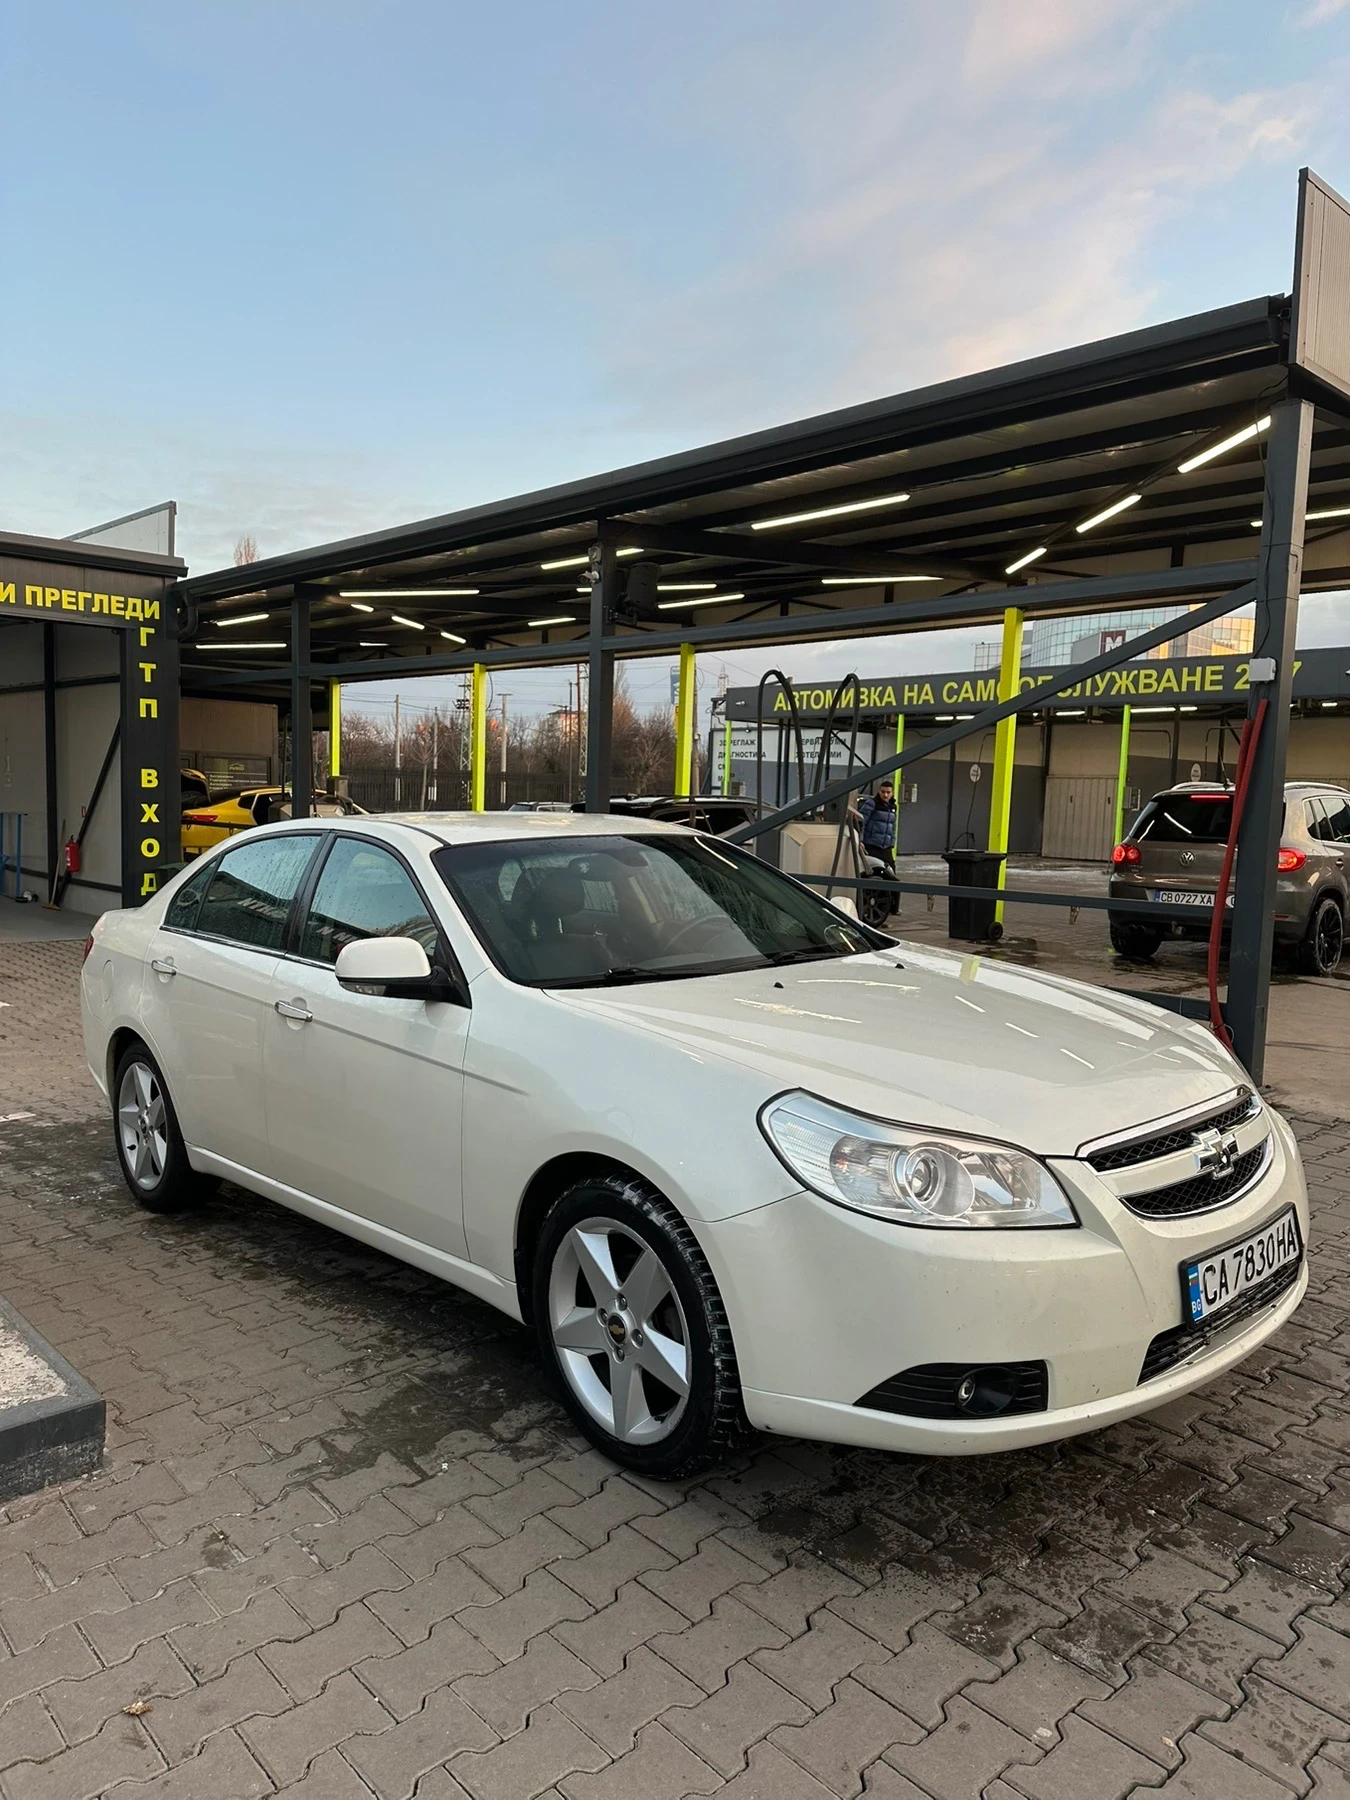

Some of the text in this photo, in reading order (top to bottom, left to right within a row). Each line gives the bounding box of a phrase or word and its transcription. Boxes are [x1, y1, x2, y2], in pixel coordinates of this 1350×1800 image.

[25, 584, 160, 621] ПРЕГЛЕДИ
[903, 683, 935, 705] НА
[139, 626, 160, 896] ГТП ВХОД
[1191, 1298, 1202, 1314] BG
